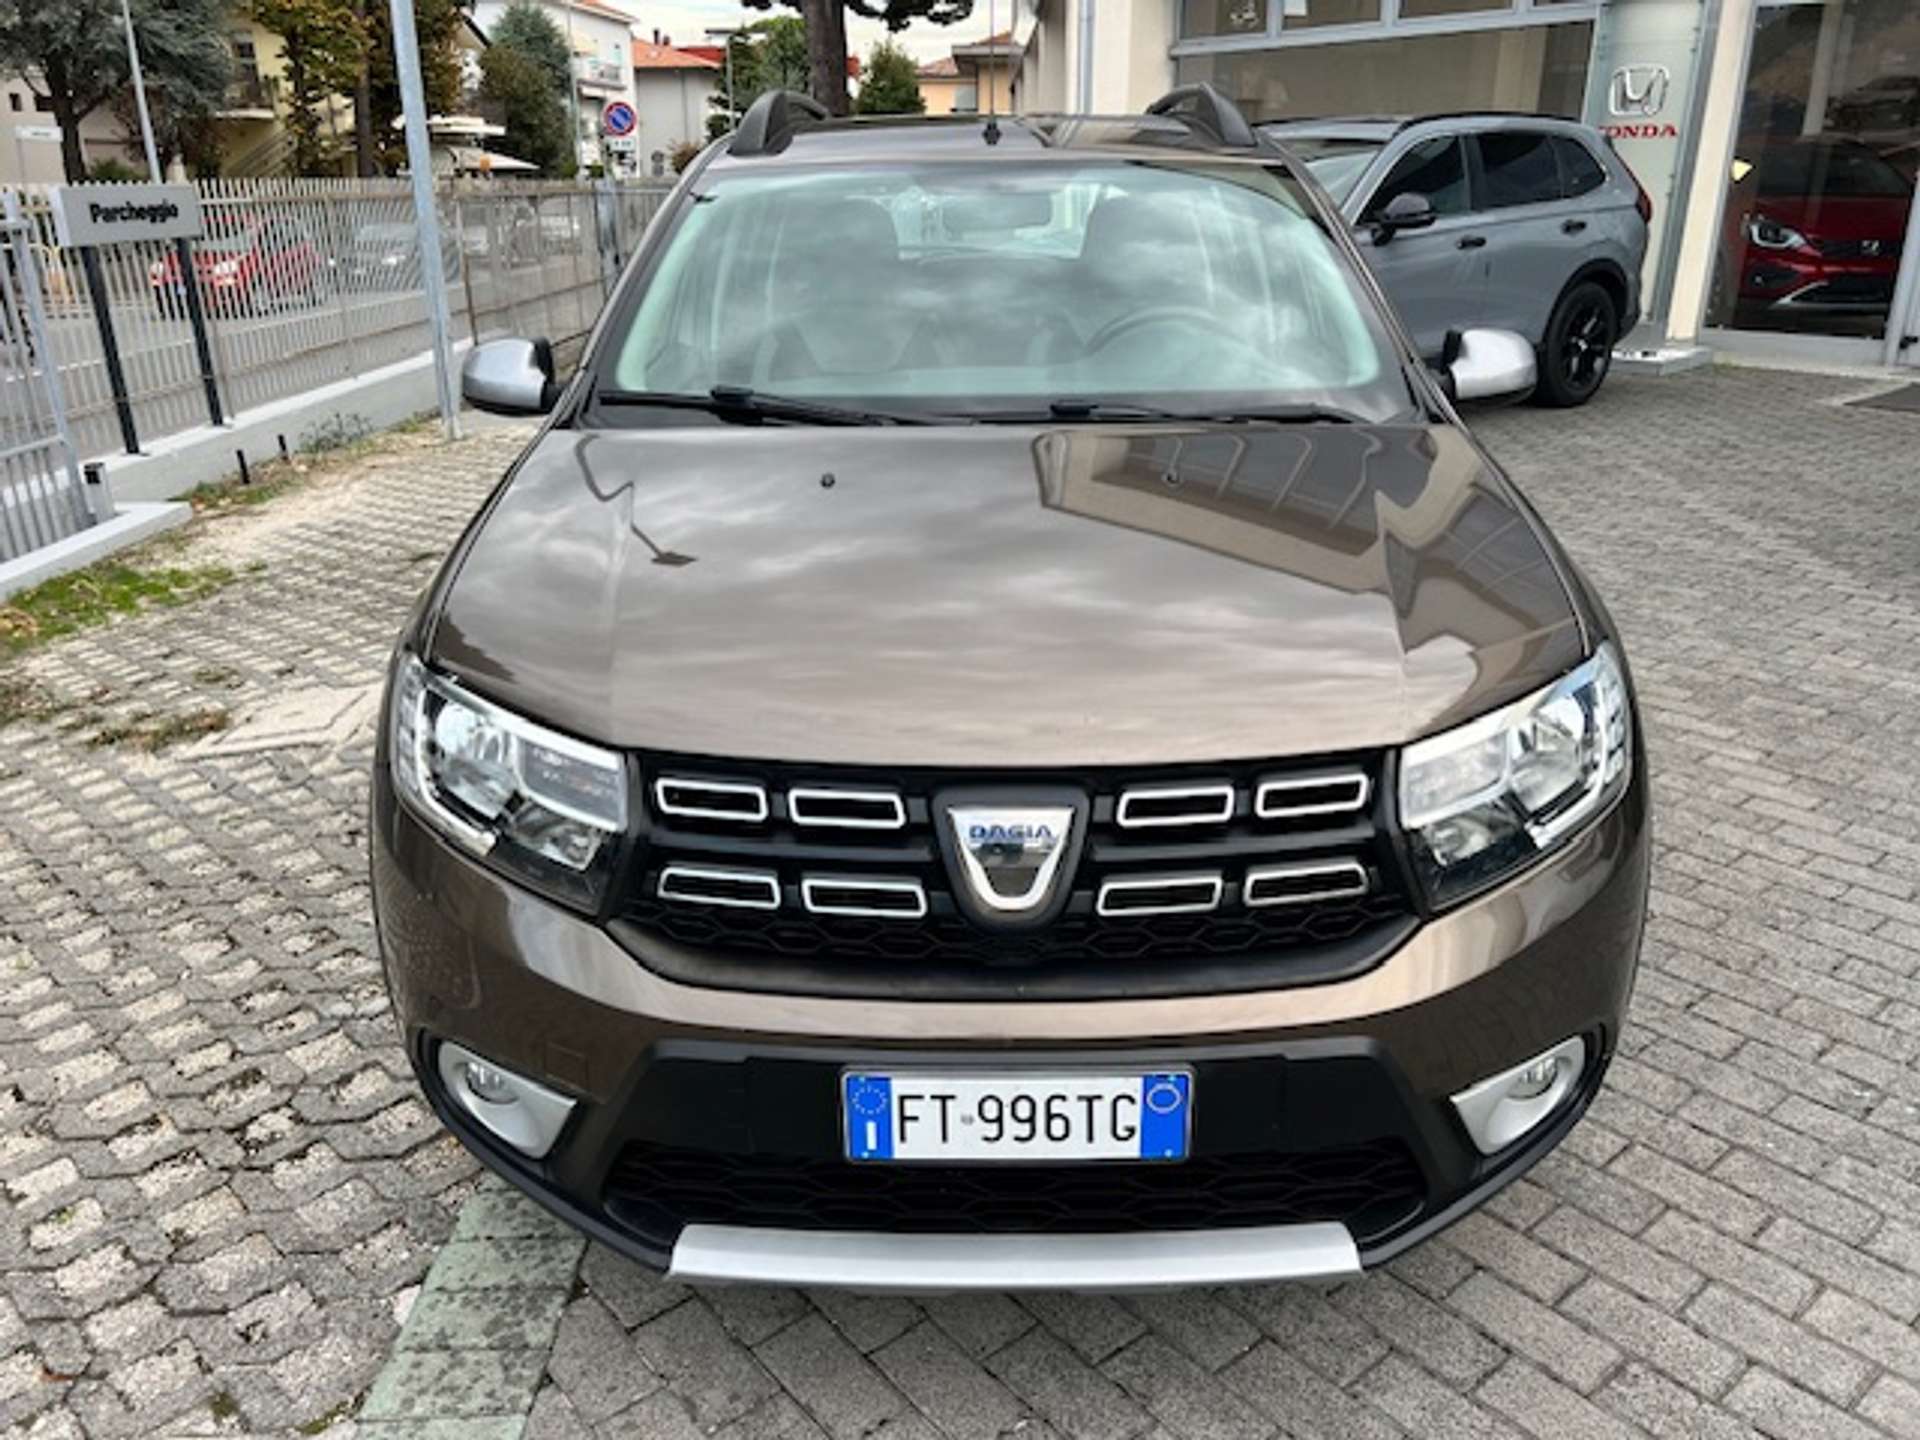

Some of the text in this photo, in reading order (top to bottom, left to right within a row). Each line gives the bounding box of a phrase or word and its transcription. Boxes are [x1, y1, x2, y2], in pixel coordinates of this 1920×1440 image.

[1598, 124, 1676, 138] ONDA
[89, 200, 178, 223] Parcheggio
[898, 1094, 1137, 1144] FT 996TG
